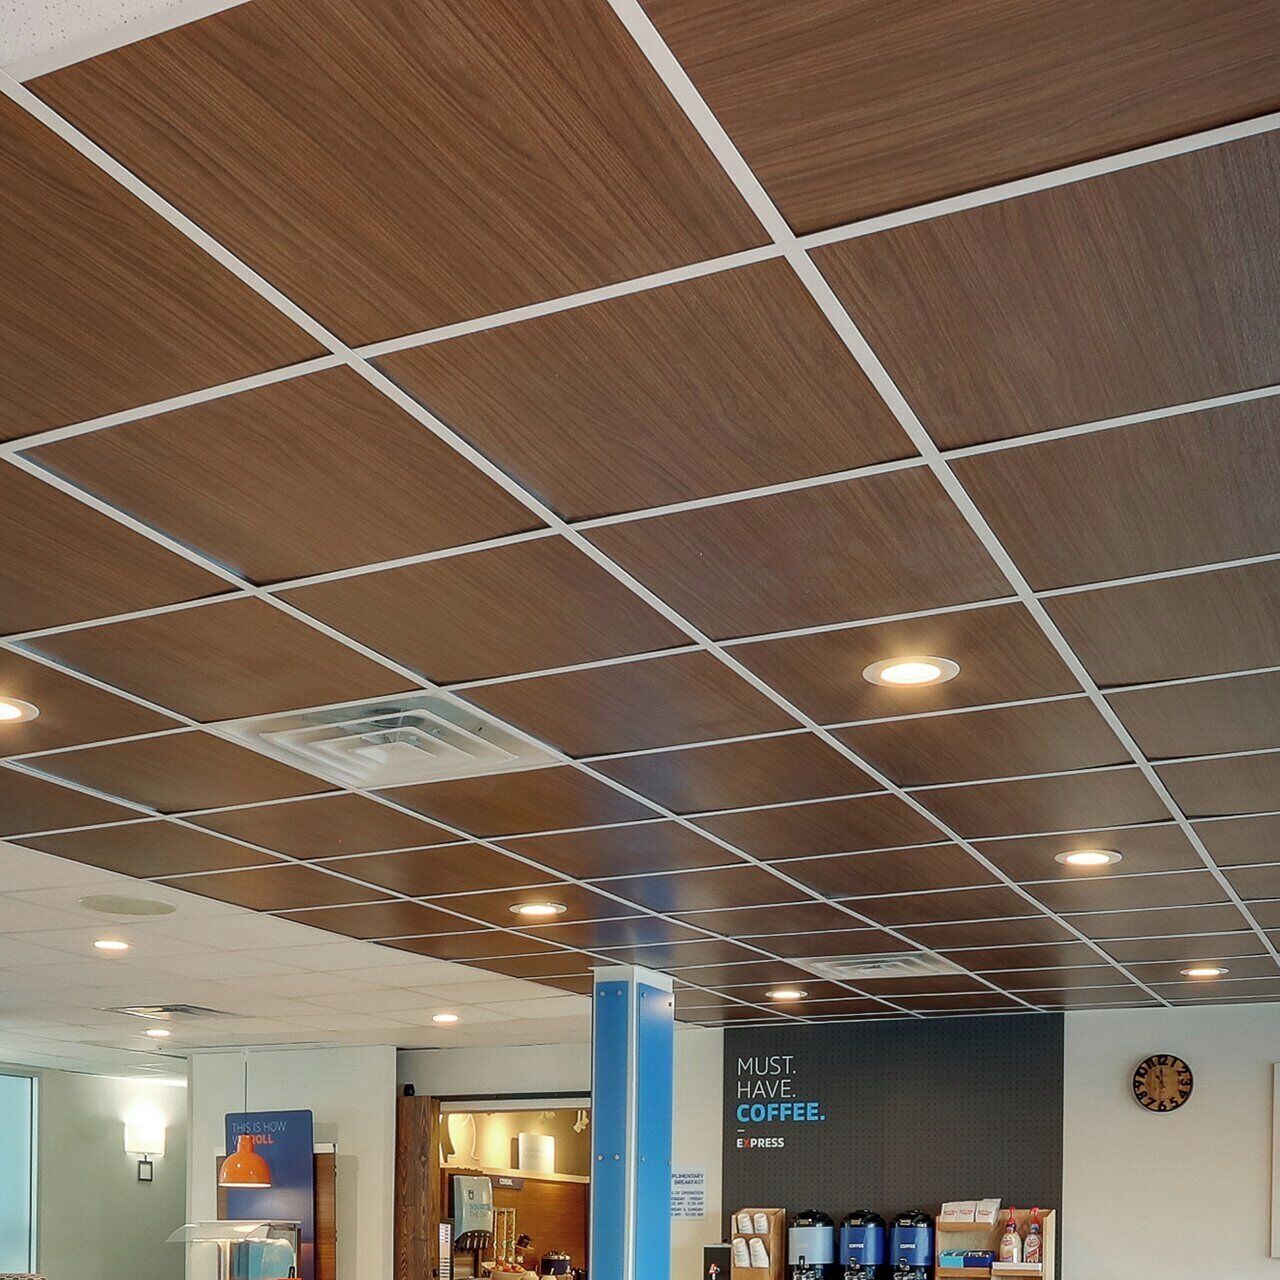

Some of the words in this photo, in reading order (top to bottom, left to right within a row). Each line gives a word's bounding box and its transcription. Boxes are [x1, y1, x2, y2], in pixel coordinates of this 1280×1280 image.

[737, 1056, 796, 1075] MUST.
[737, 1079, 796, 1099] HAVE.
[737, 1102, 826, 1122] COFFEE.
[232, 1122, 251, 1133] THIS
[253, 1121, 261, 1132] IS
[263, 1121, 286, 1132] HOW
[737, 1138, 785, 1148] EXPRESS
